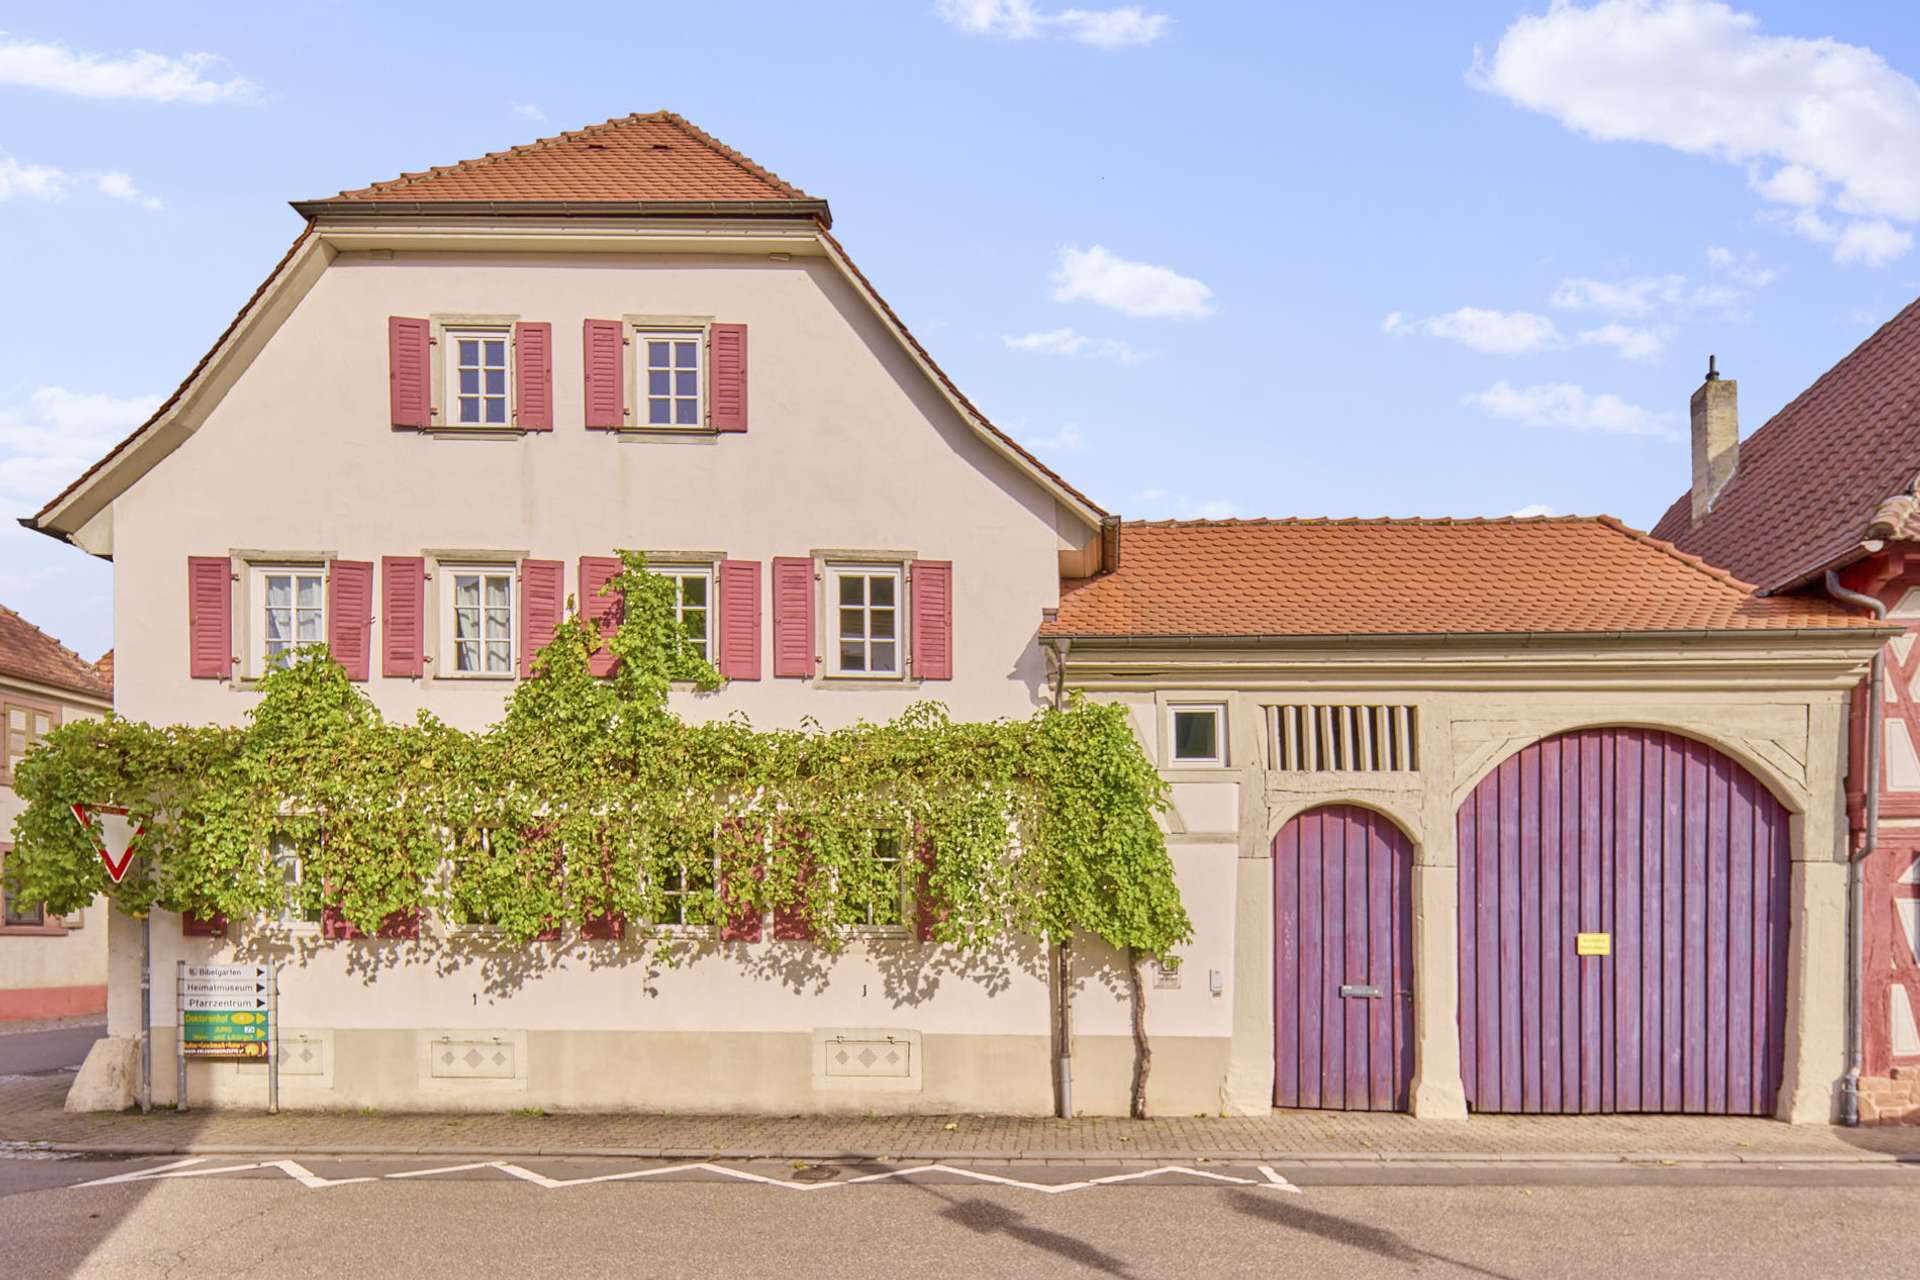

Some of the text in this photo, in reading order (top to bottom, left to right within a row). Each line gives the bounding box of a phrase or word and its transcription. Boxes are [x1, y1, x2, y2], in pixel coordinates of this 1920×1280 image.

[199, 967, 242, 977] Bibelgarten
[187, 983, 253, 992] Heimatmuseum
[188, 998, 252, 1008] Pfarrzentrum
